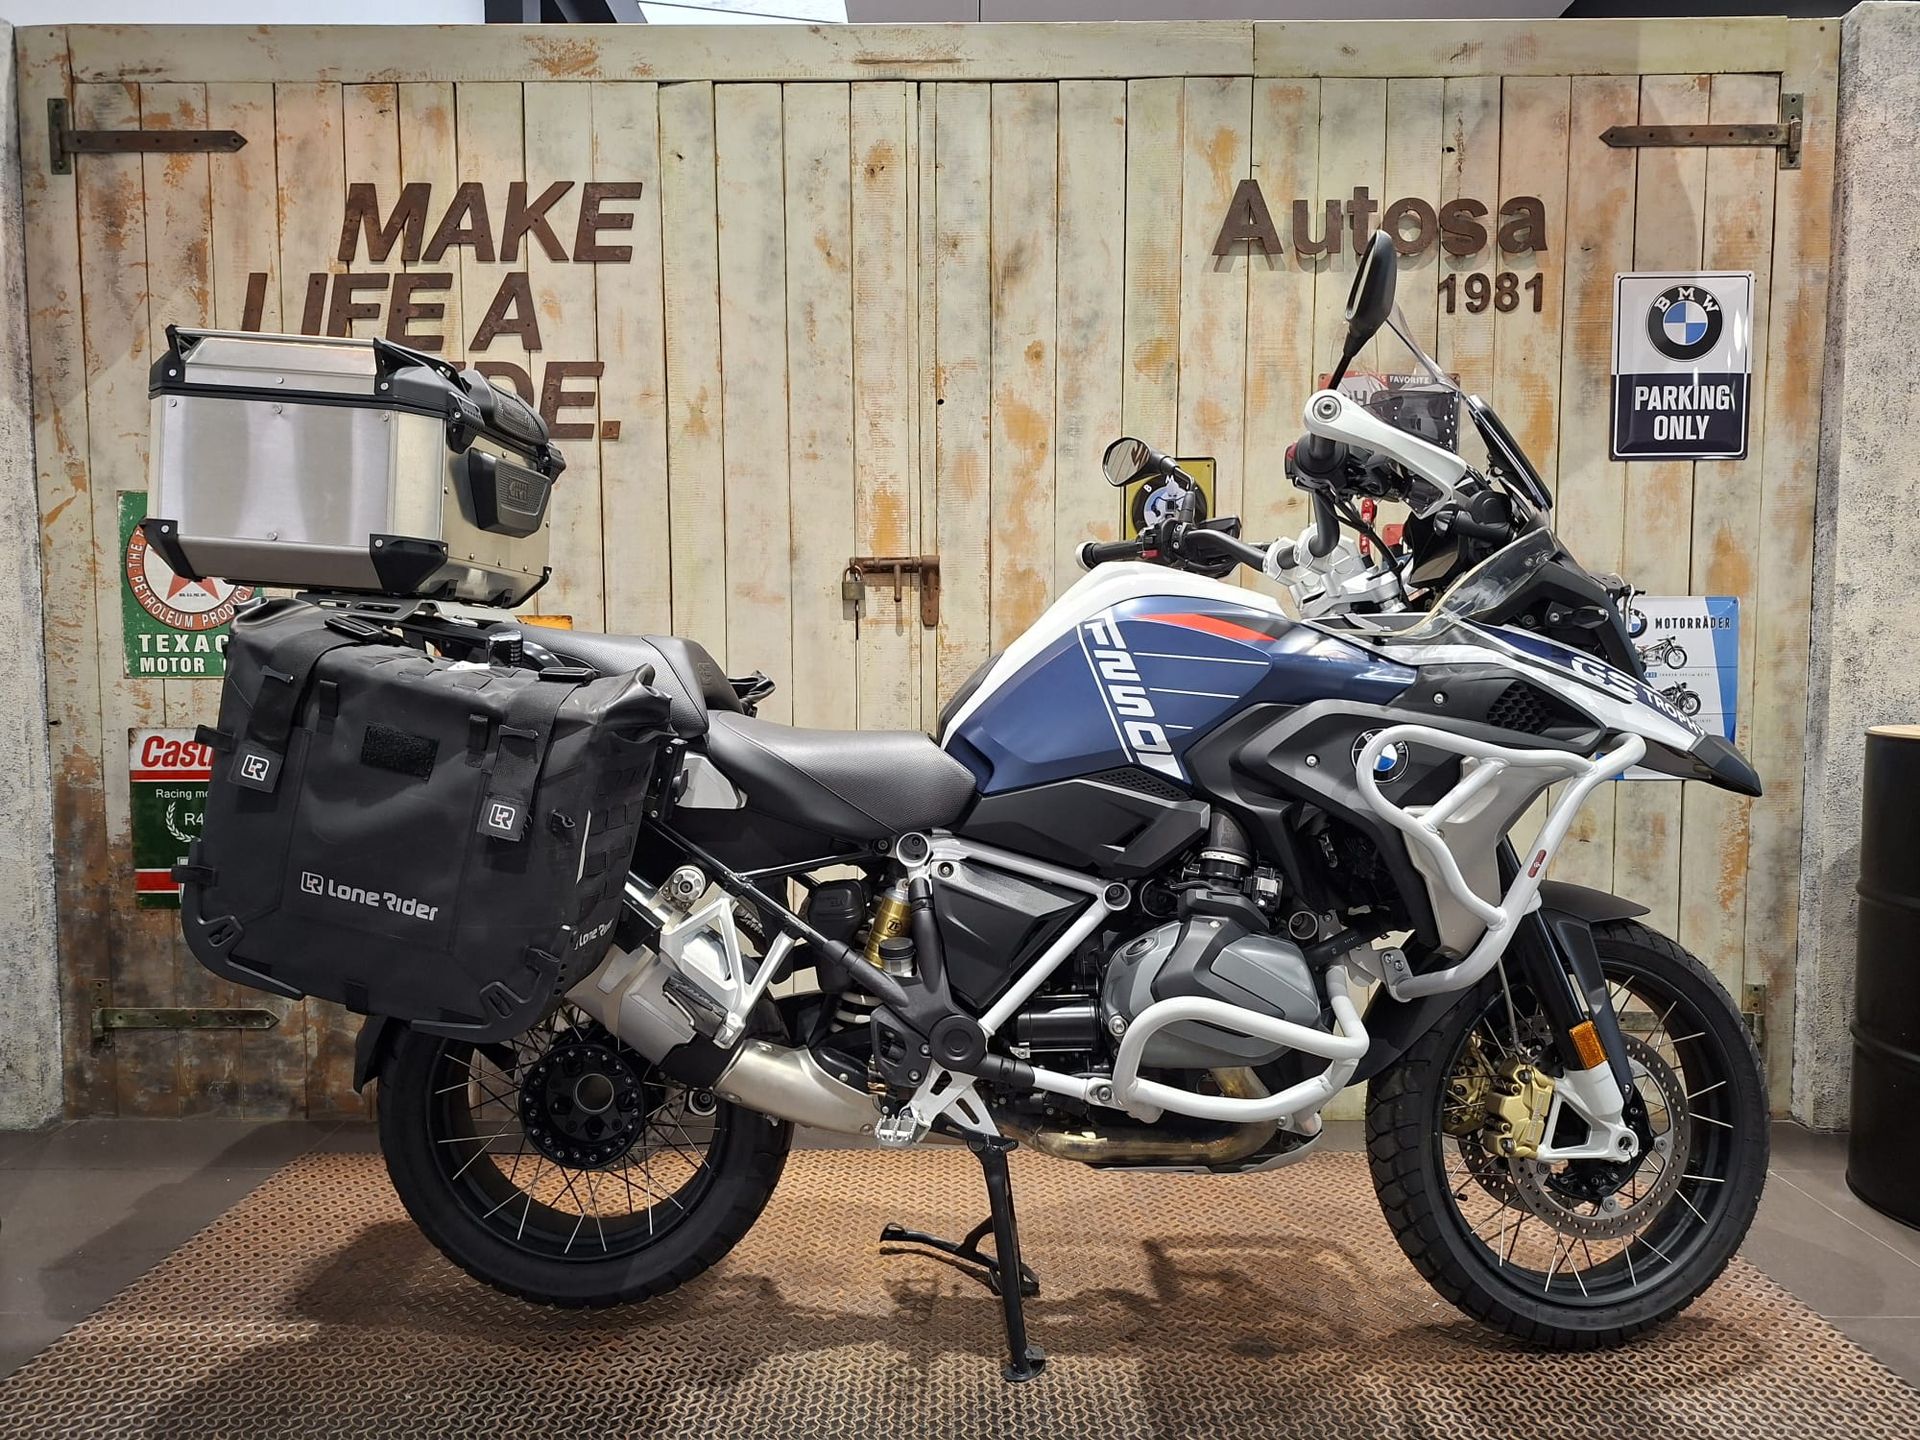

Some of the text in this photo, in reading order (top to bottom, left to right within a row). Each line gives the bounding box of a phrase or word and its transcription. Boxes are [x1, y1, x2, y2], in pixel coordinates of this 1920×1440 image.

[337, 181, 643, 262] MAKE
[1212, 179, 1548, 255] Autosa
[1437, 272, 1544, 313] 1981
[1654, 287, 1720, 313] BMW
[468, 272, 543, 351] A
[1389, 375, 1430, 385] FAVORITE
[1634, 385, 1731, 411] PARKING
[1653, 415, 1710, 441] ONLY
[131, 576, 194, 628] PETROLEUM
[1655, 615, 1730, 629] MOTORRÄDER
[140, 657, 206, 673] MOTOR
[155, 788, 192, 800] Racing
[327, 879, 380, 907] Lone
[383, 892, 439, 921] Rider
